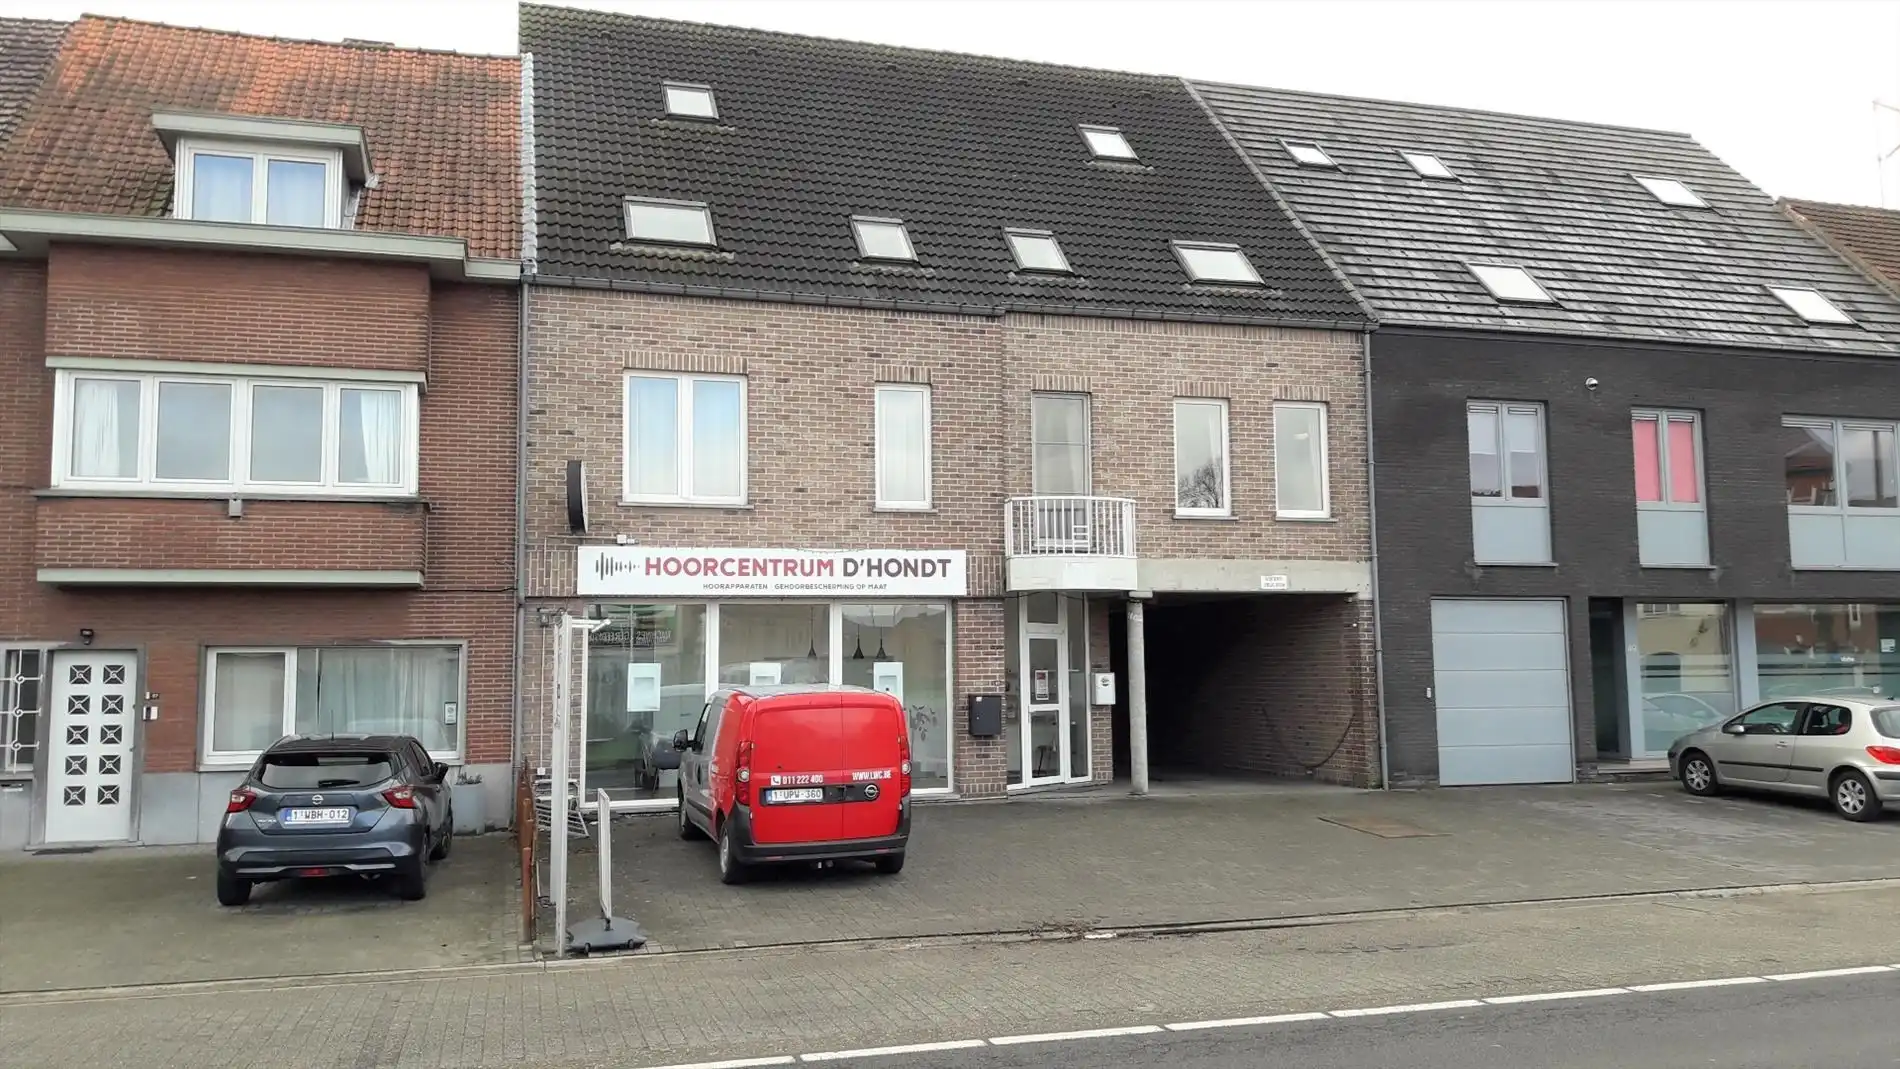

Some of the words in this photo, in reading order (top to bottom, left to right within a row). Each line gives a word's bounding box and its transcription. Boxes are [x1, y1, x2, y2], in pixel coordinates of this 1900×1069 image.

[645, 557, 833, 577] HOORCENTRUM
[842, 558, 951, 577] D'HONDT
[797, 774, 810, 784] 222
